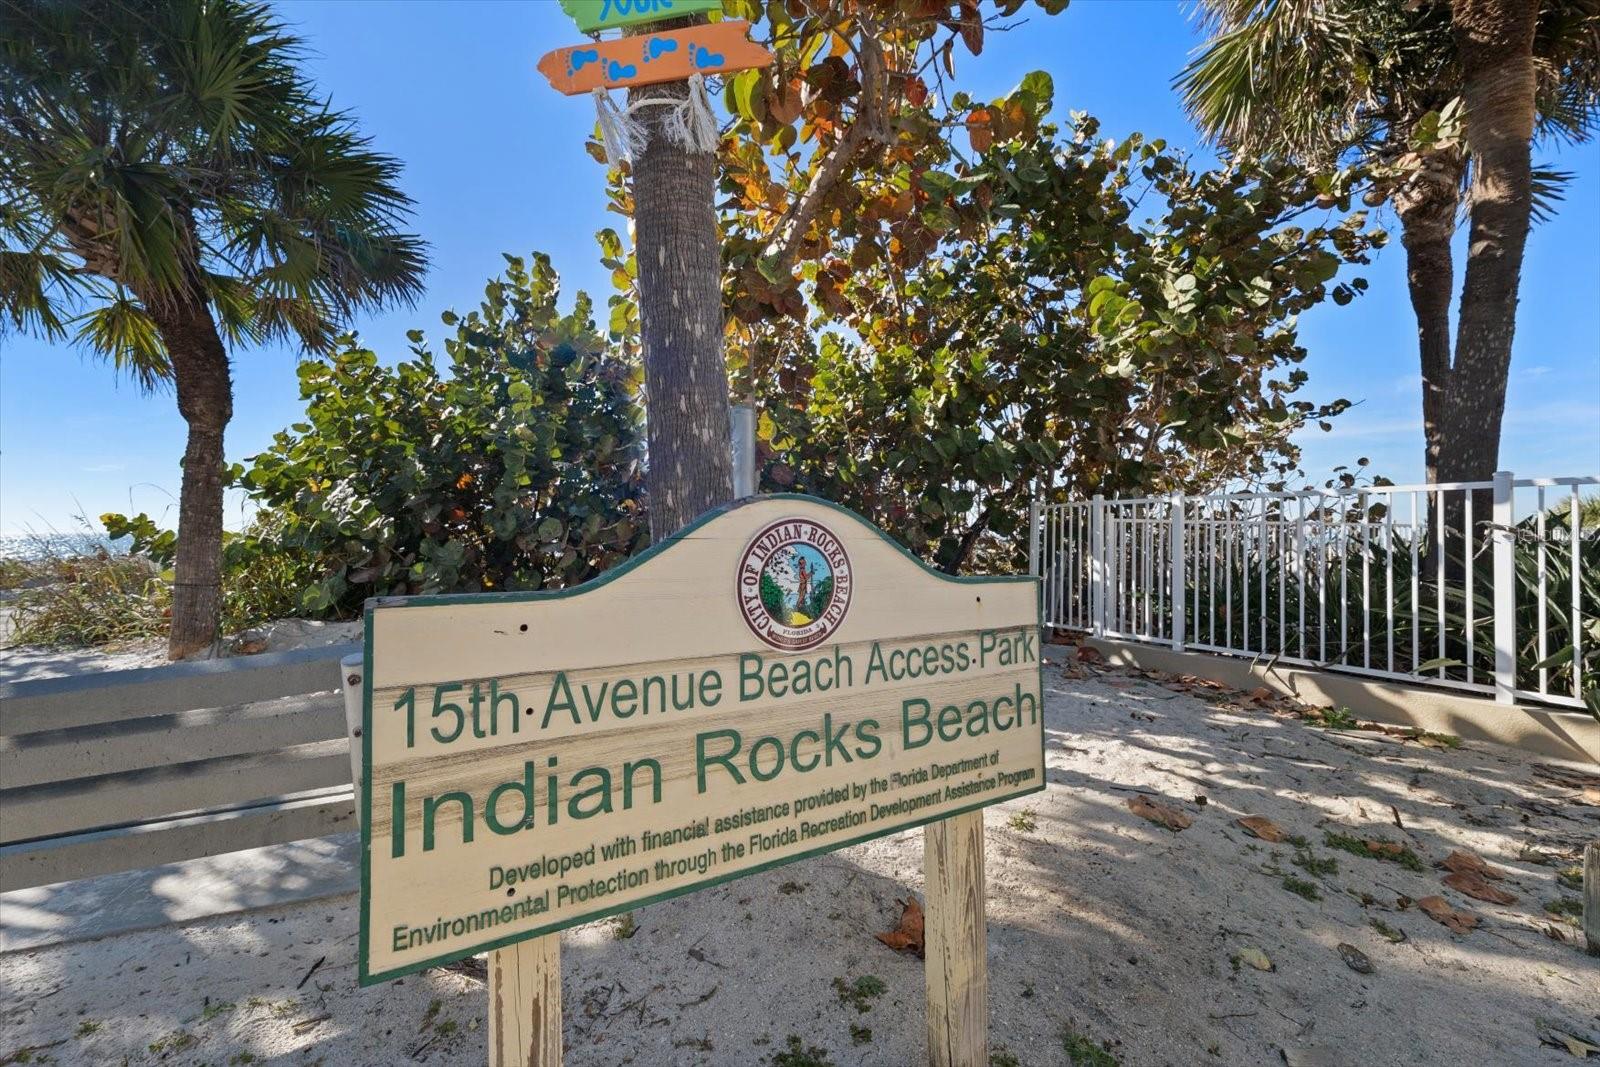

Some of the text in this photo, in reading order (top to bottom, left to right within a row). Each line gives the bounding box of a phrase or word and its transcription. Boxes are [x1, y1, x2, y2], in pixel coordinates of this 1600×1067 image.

[743, 524, 848, 630] CITY OF INDIAN ROCKS BEACH
[393, 628, 1036, 748] 15th Avenue Beach Access Park
[391, 683, 1037, 859] Indian Rocks Beach
[490, 750, 1000, 891] Developed with financial assistance provided by the Florida Department of
[393, 766, 1036, 952] Environmental Protection through the Florida Recreation Development Assistance Program
